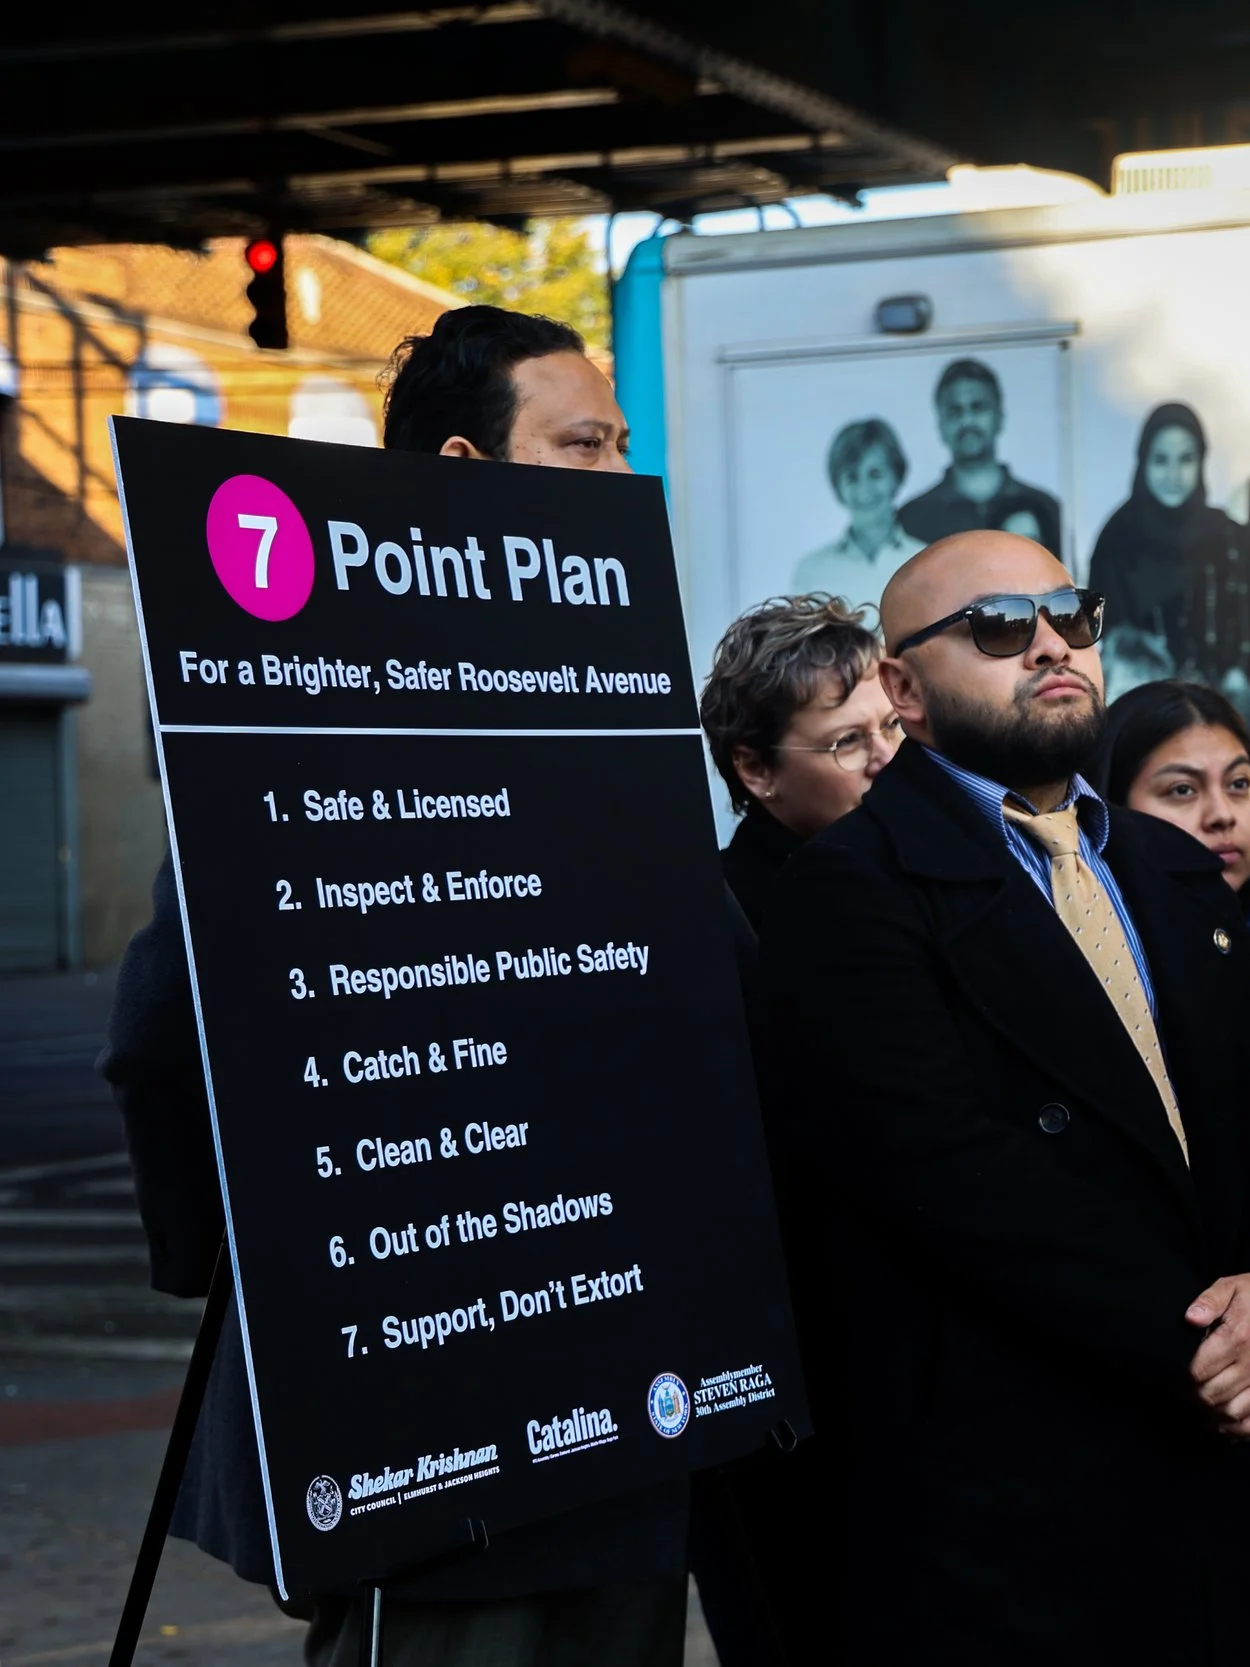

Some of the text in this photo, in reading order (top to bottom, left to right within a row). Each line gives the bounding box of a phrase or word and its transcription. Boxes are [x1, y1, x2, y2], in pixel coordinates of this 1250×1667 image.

[237, 513, 630, 606] 7 Point Plan
[180, 651, 671, 695] For a Brighter, Safer Roosevelt Avenue
[264, 788, 511, 822] 1. Safe & Licensed
[276, 870, 543, 914] 2. Inspect & Enforce
[290, 942, 649, 1000] 3. Responsible Public Safety
[304, 1037, 508, 1088] 4. Catch & Fine
[317, 1121, 529, 1178] 5. Clean & Clear
[329, 1192, 614, 1268] 6. Out of the Shadows
[341, 1263, 644, 1358] 7. Support, Don’t Extort
[694, 1373, 772, 1405] STEVEN RAGA
[700, 1364, 763, 1388] Assemblymember
[713, 1395, 747, 1414] Assembly
[748, 1387, 776, 1403] District
[526, 1406, 618, 1455] Catalina.
[348, 1467, 414, 1500] Shekar
[416, 1444, 499, 1482] Krishnan
[350, 1505, 366, 1516] CITY
[366, 1496, 397, 1511] COUNCIL
[403, 1484, 437, 1501] ELMHURST
[444, 1474, 473, 1489] JACKSON
[474, 1466, 500, 1480] HEIGHTS
